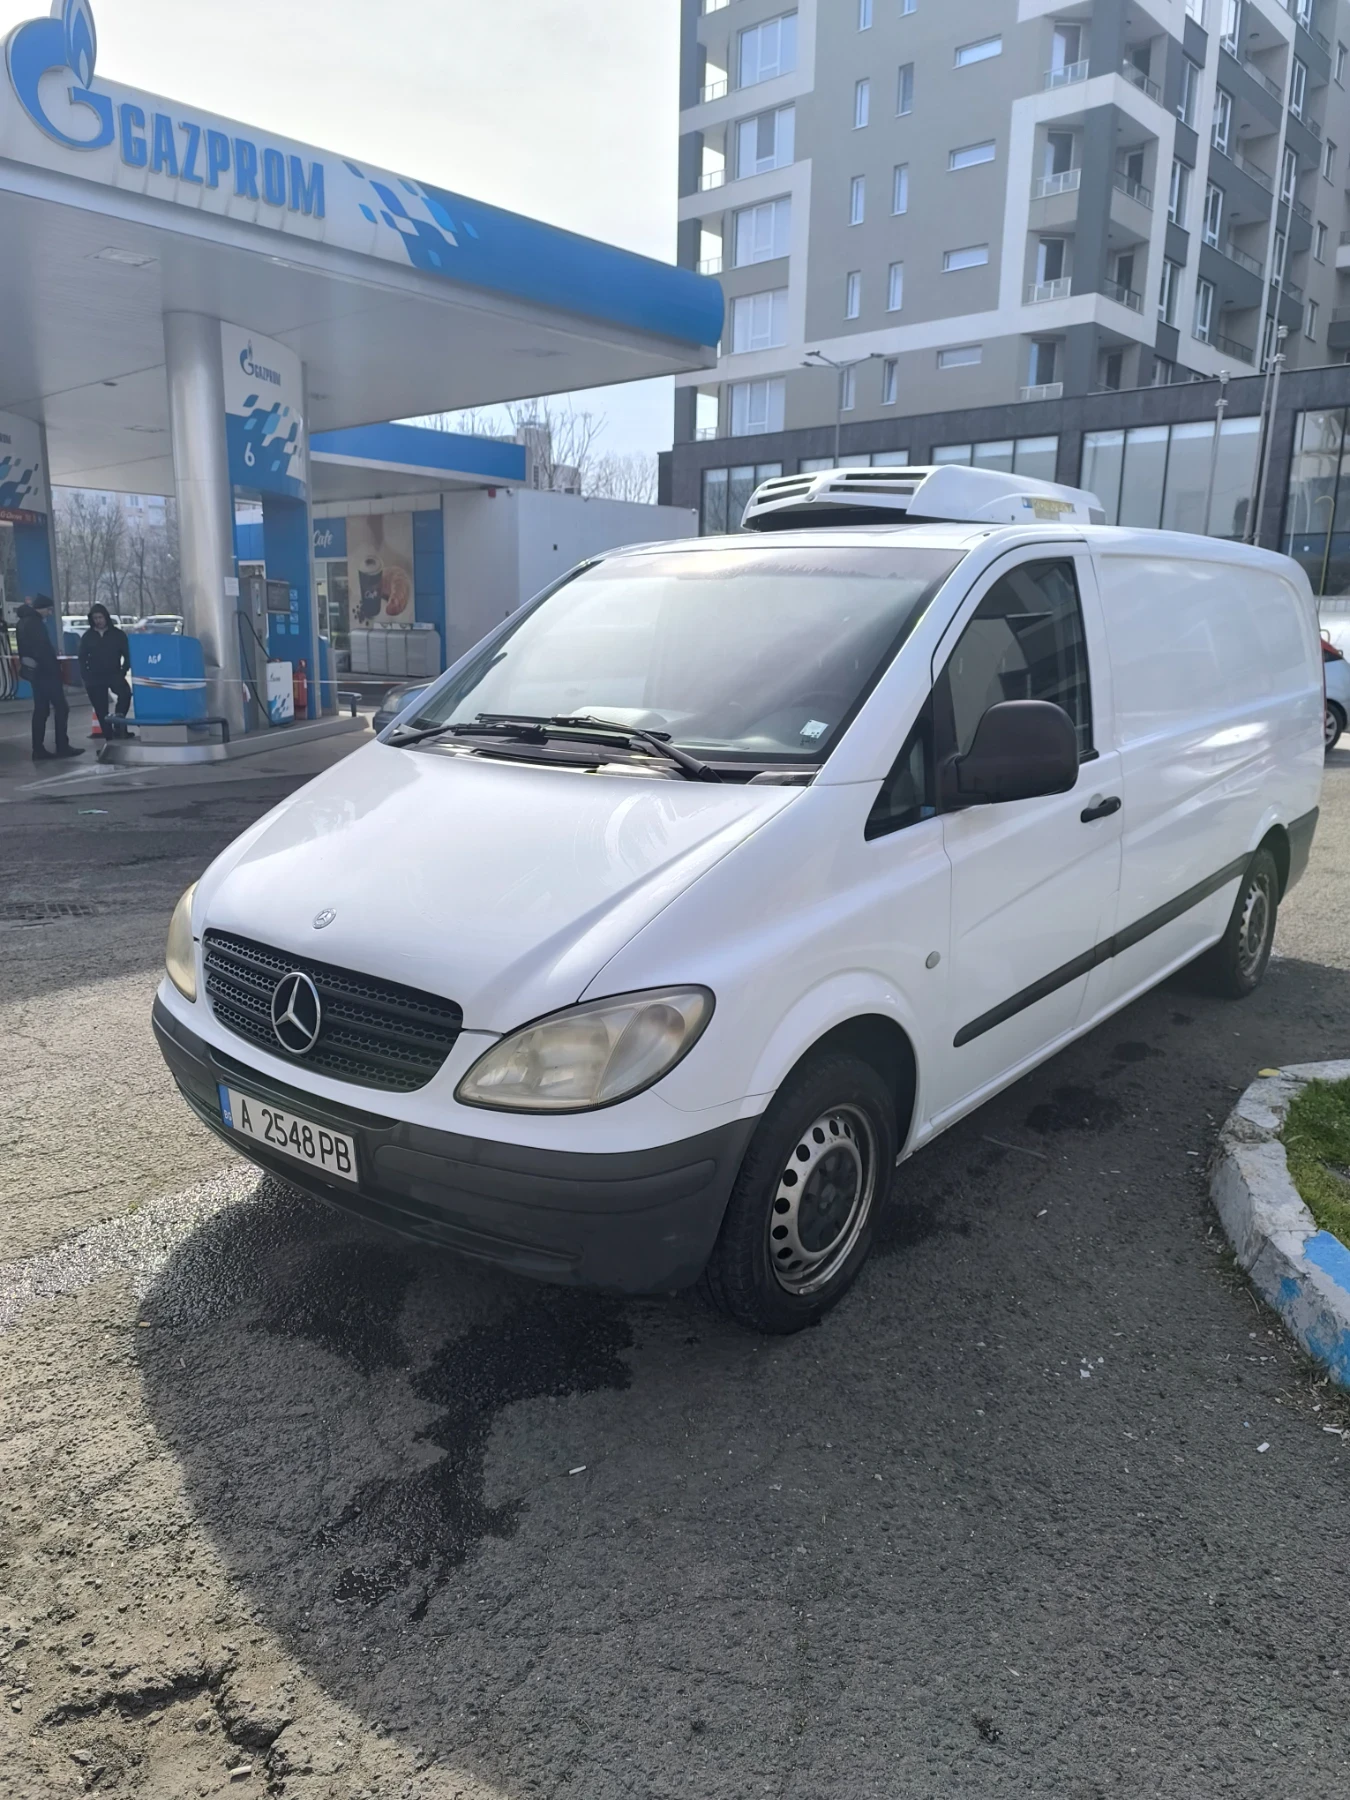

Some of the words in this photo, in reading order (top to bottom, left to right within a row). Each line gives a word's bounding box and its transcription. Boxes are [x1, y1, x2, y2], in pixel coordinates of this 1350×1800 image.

[118, 102, 326, 219] GAZPROM
[254, 364, 281, 387] GAZPROM
[244, 442, 255, 467] 6
[223, 1109, 232, 1121] BG
[241, 1099, 253, 1133] A
[261, 1108, 316, 1159] 2548
[318, 1130, 351, 1173] PB
